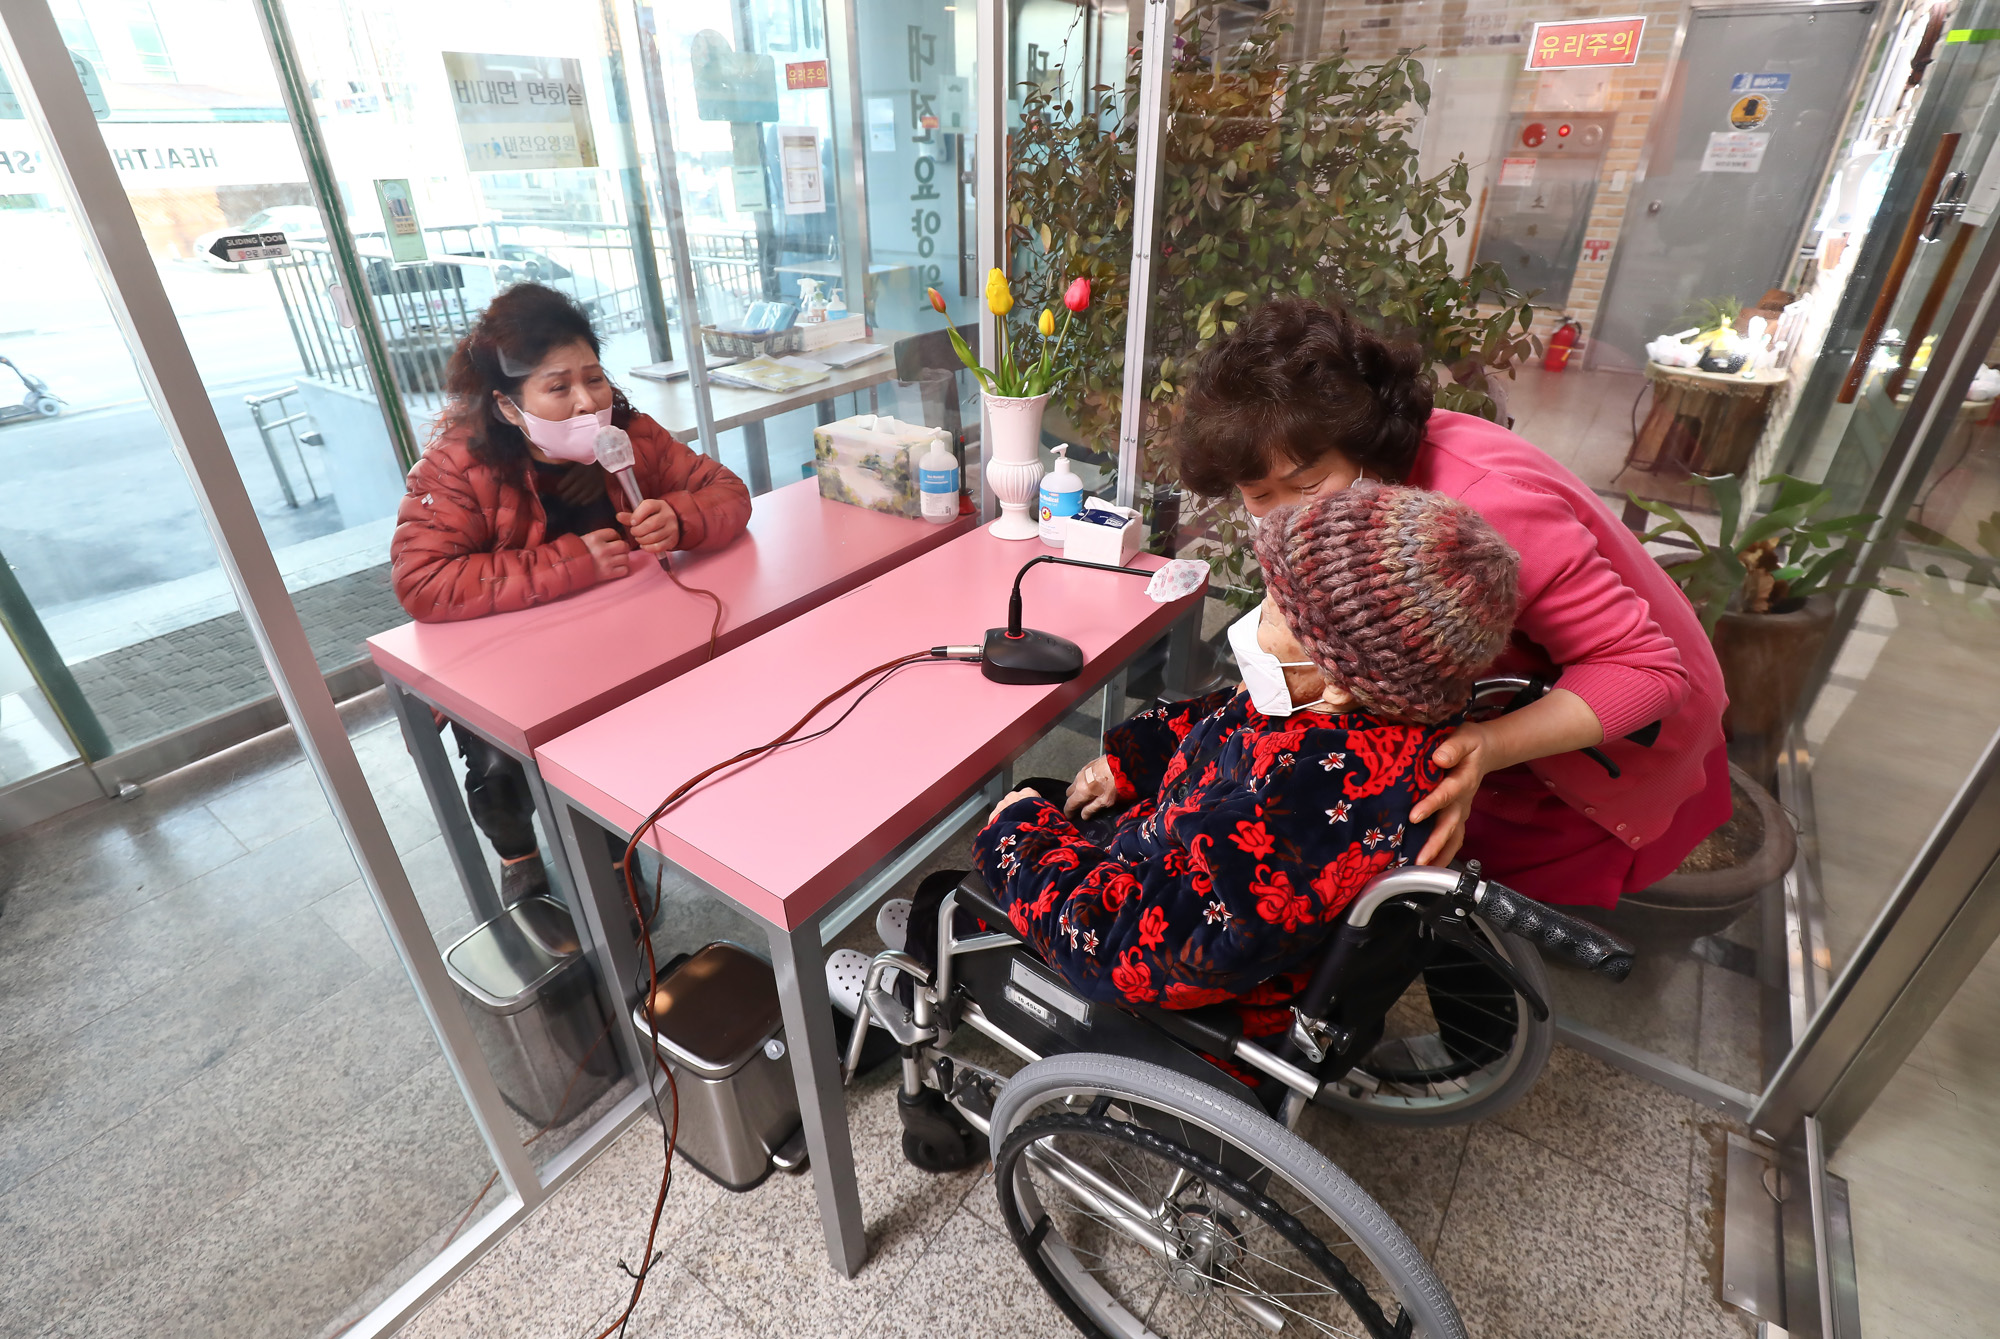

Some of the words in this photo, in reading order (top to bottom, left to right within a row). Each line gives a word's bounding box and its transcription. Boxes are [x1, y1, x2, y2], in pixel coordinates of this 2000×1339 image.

[1539, 30, 1634, 59] 유리주의
[788, 66, 826, 86] 유리주의
[454, 79, 520, 105] 비대면
[527, 82, 584, 106] 면회실
[502, 135, 578, 153] 대전요양원
[226, 237, 258, 246] SLIDING
[259, 234, 284, 243] DOOR
